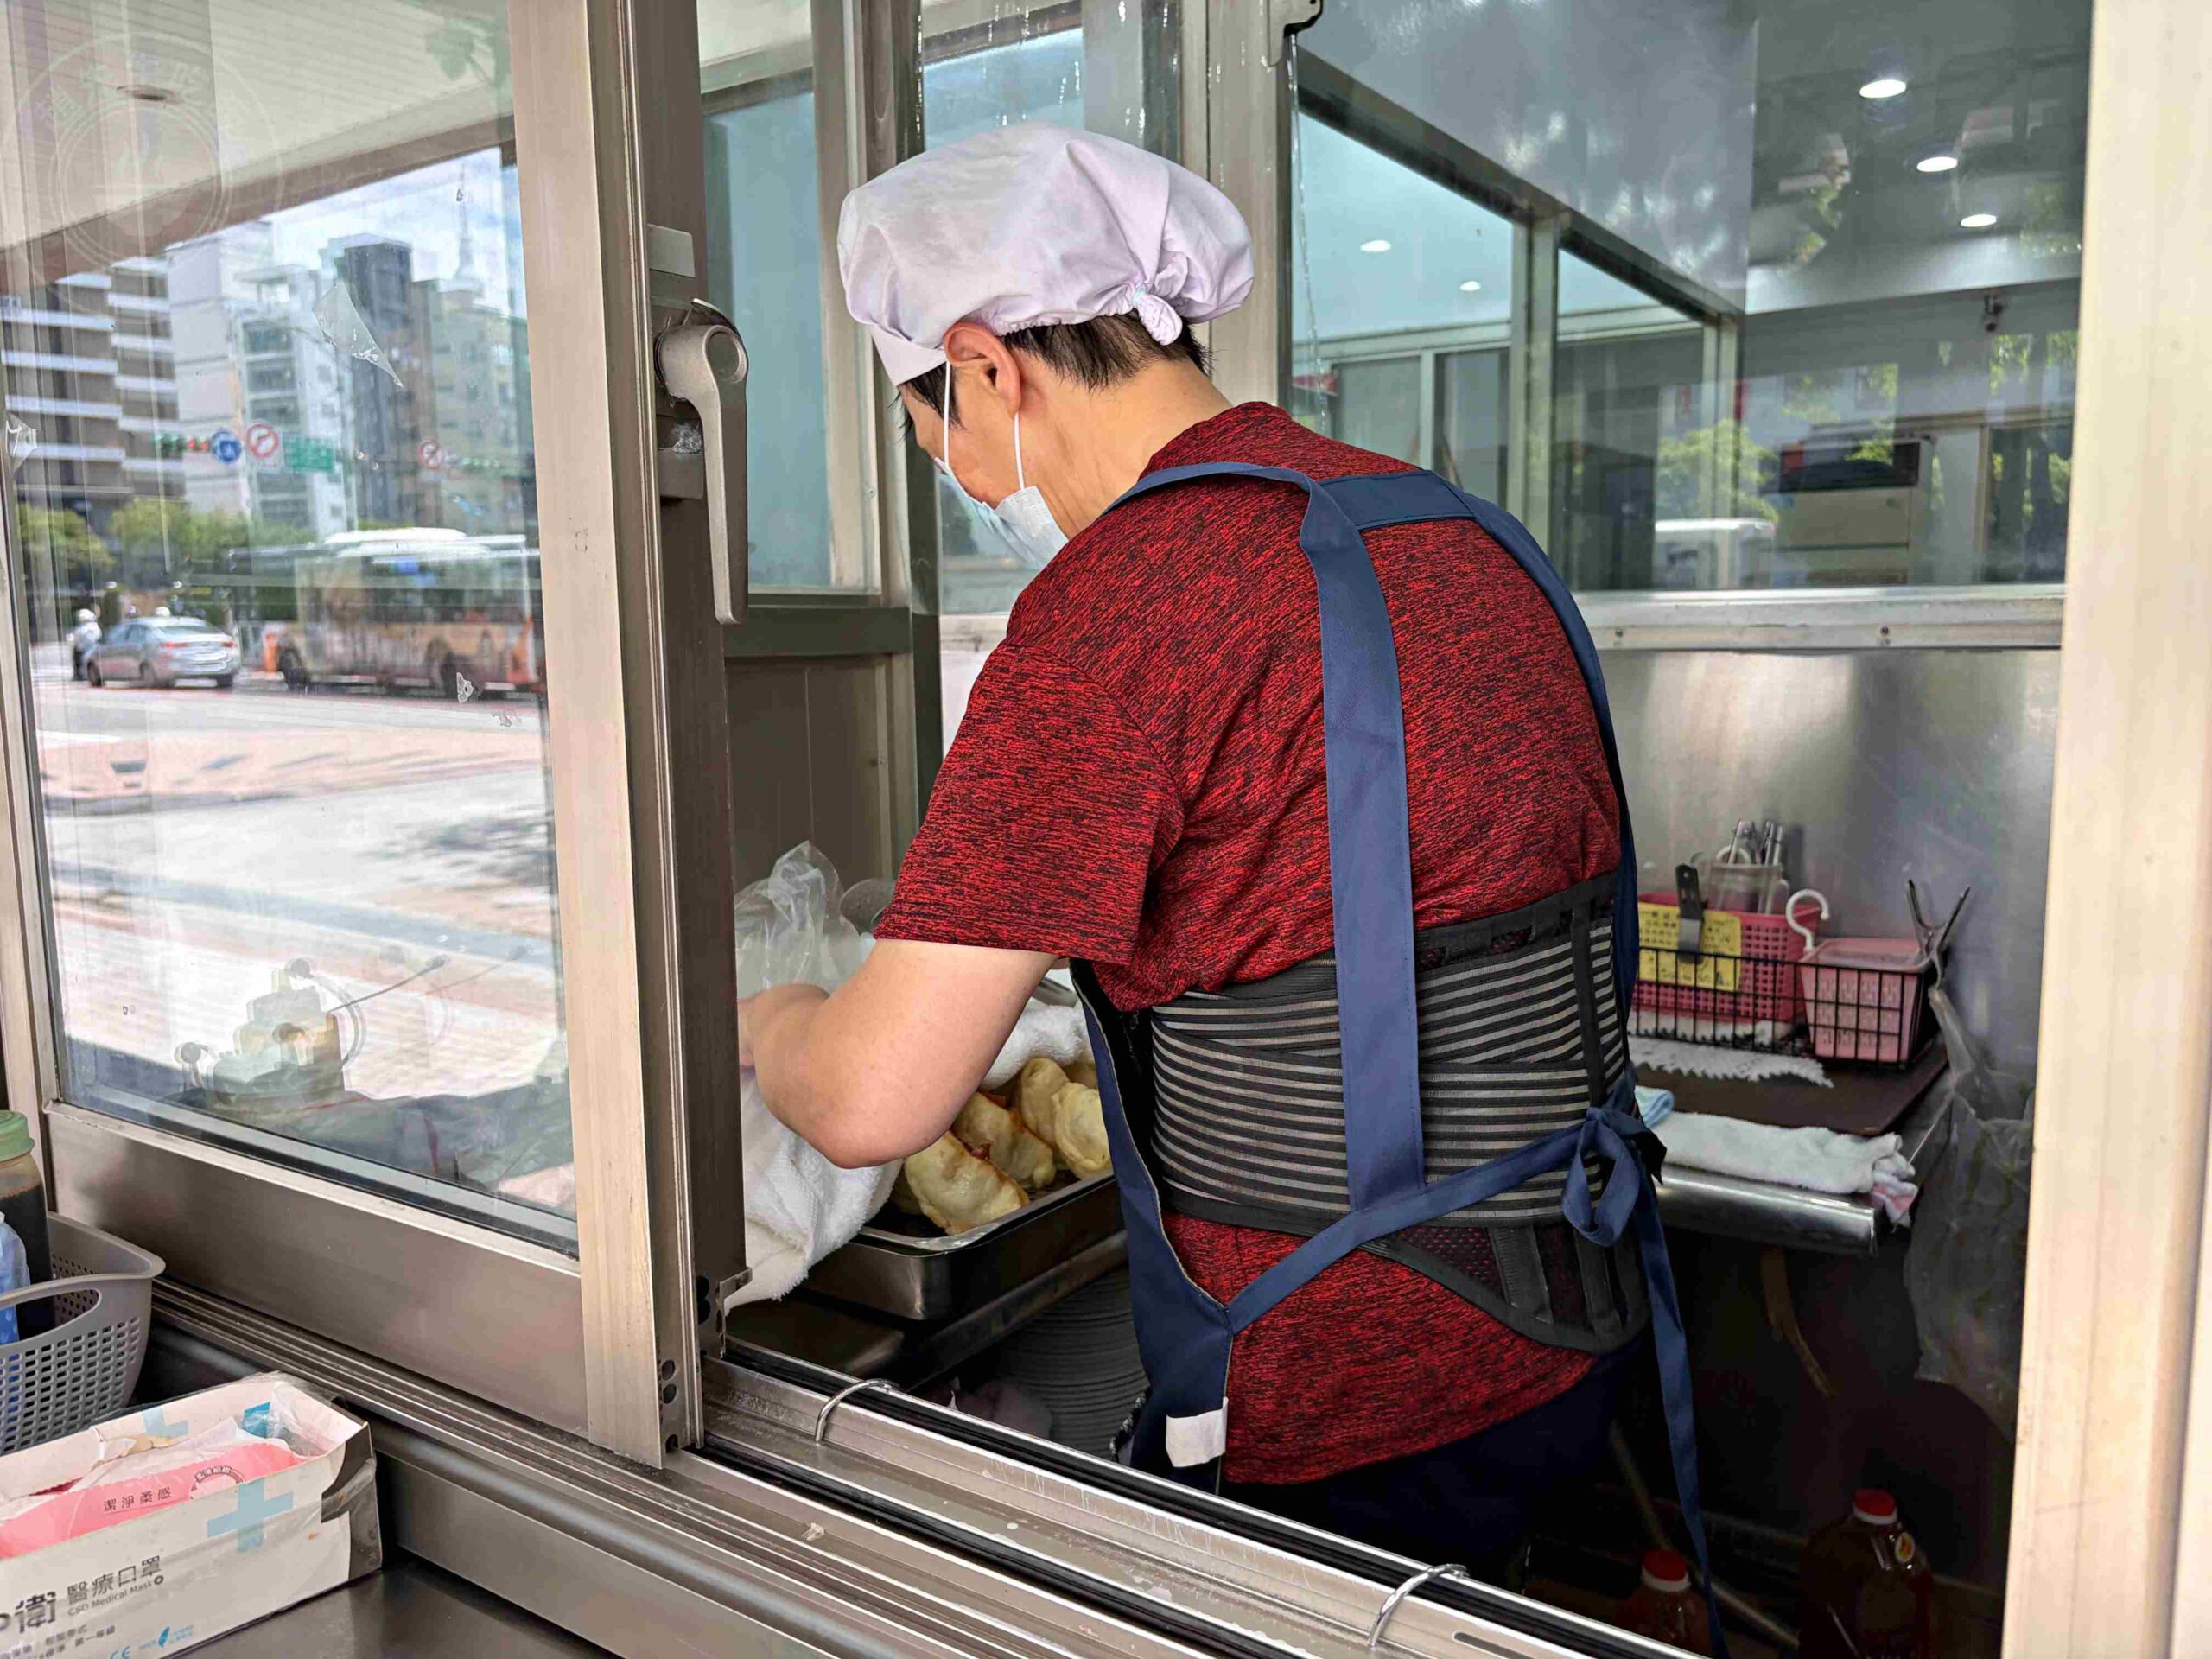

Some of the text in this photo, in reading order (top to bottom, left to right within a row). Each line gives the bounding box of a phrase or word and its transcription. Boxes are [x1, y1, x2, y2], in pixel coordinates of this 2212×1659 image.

[104, 1486, 171, 1512] 潔淨柔感
[67, 1555, 162, 1605] 醫療口罩
[68, 1580, 152, 1616] CSD Medical Mask
[0, 1592, 56, 1633] 衛
